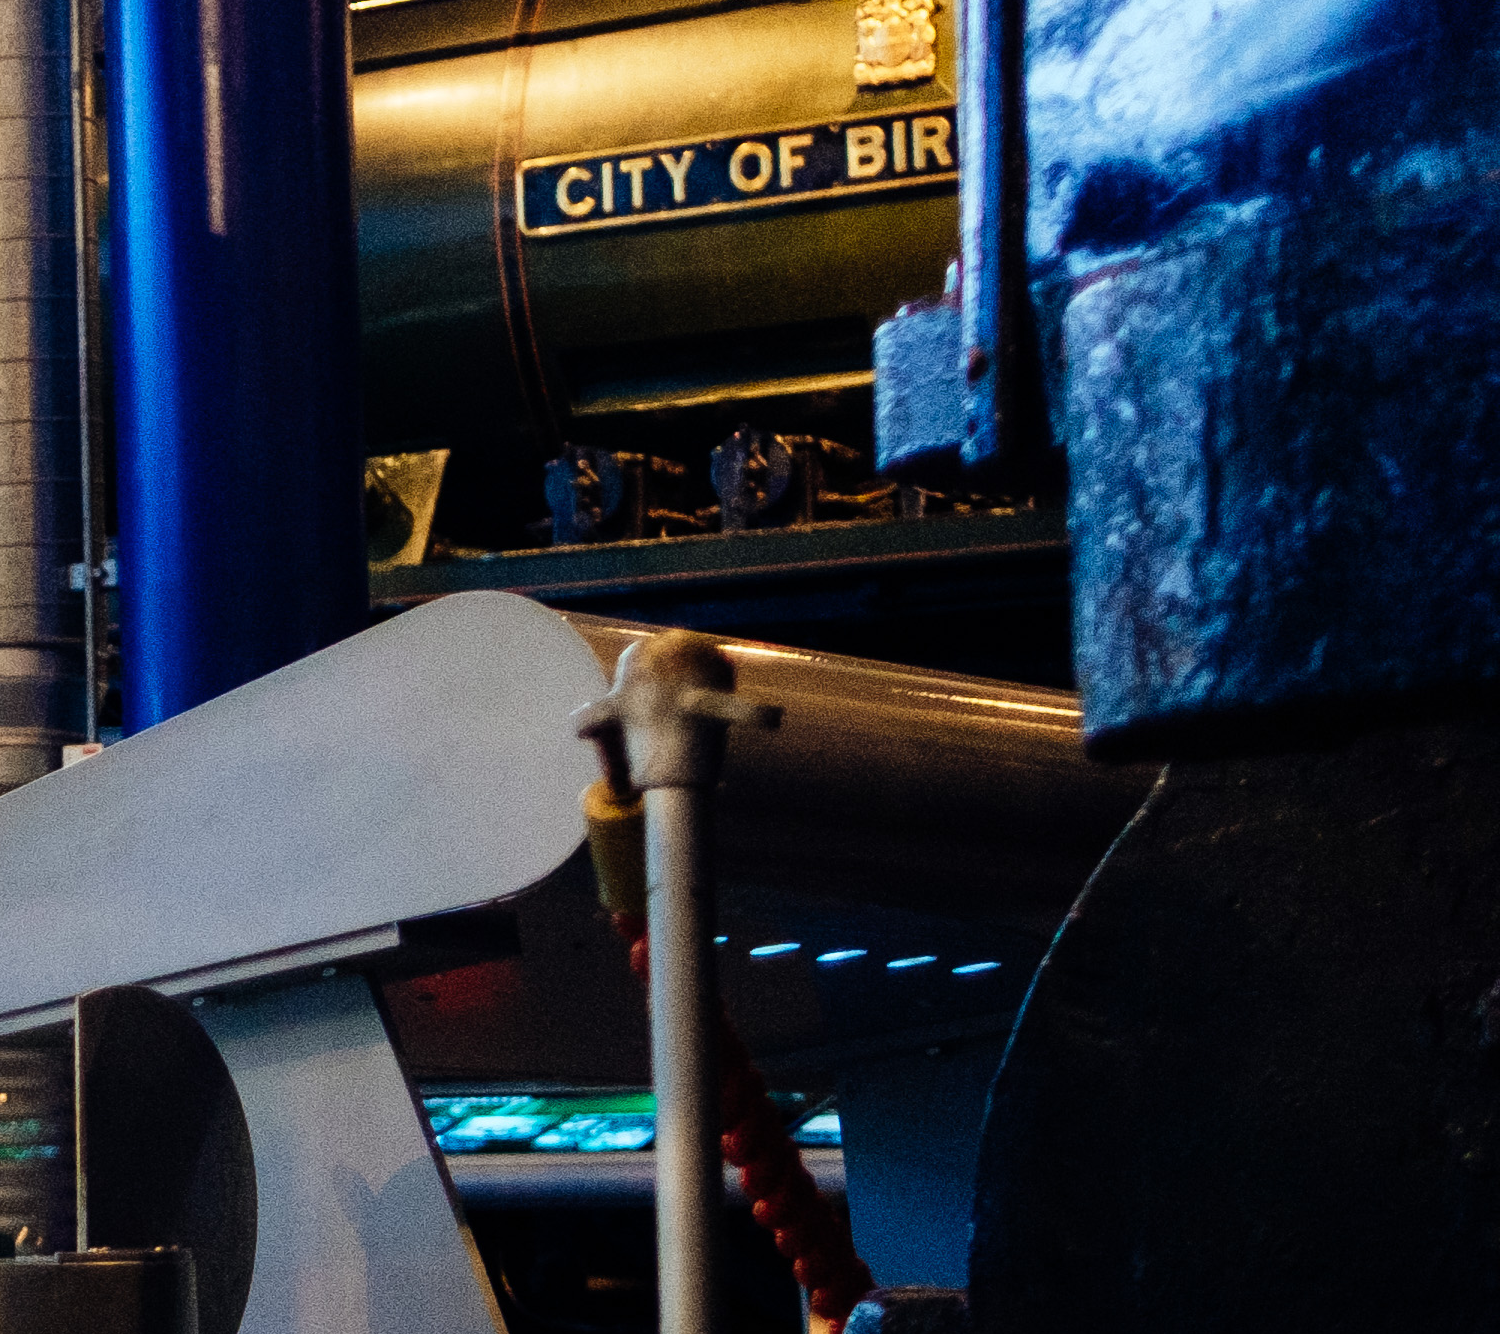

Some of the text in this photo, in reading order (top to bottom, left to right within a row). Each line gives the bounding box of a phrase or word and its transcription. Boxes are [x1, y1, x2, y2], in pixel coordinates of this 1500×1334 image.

[556, 114, 954, 218] CITY OF BIR
